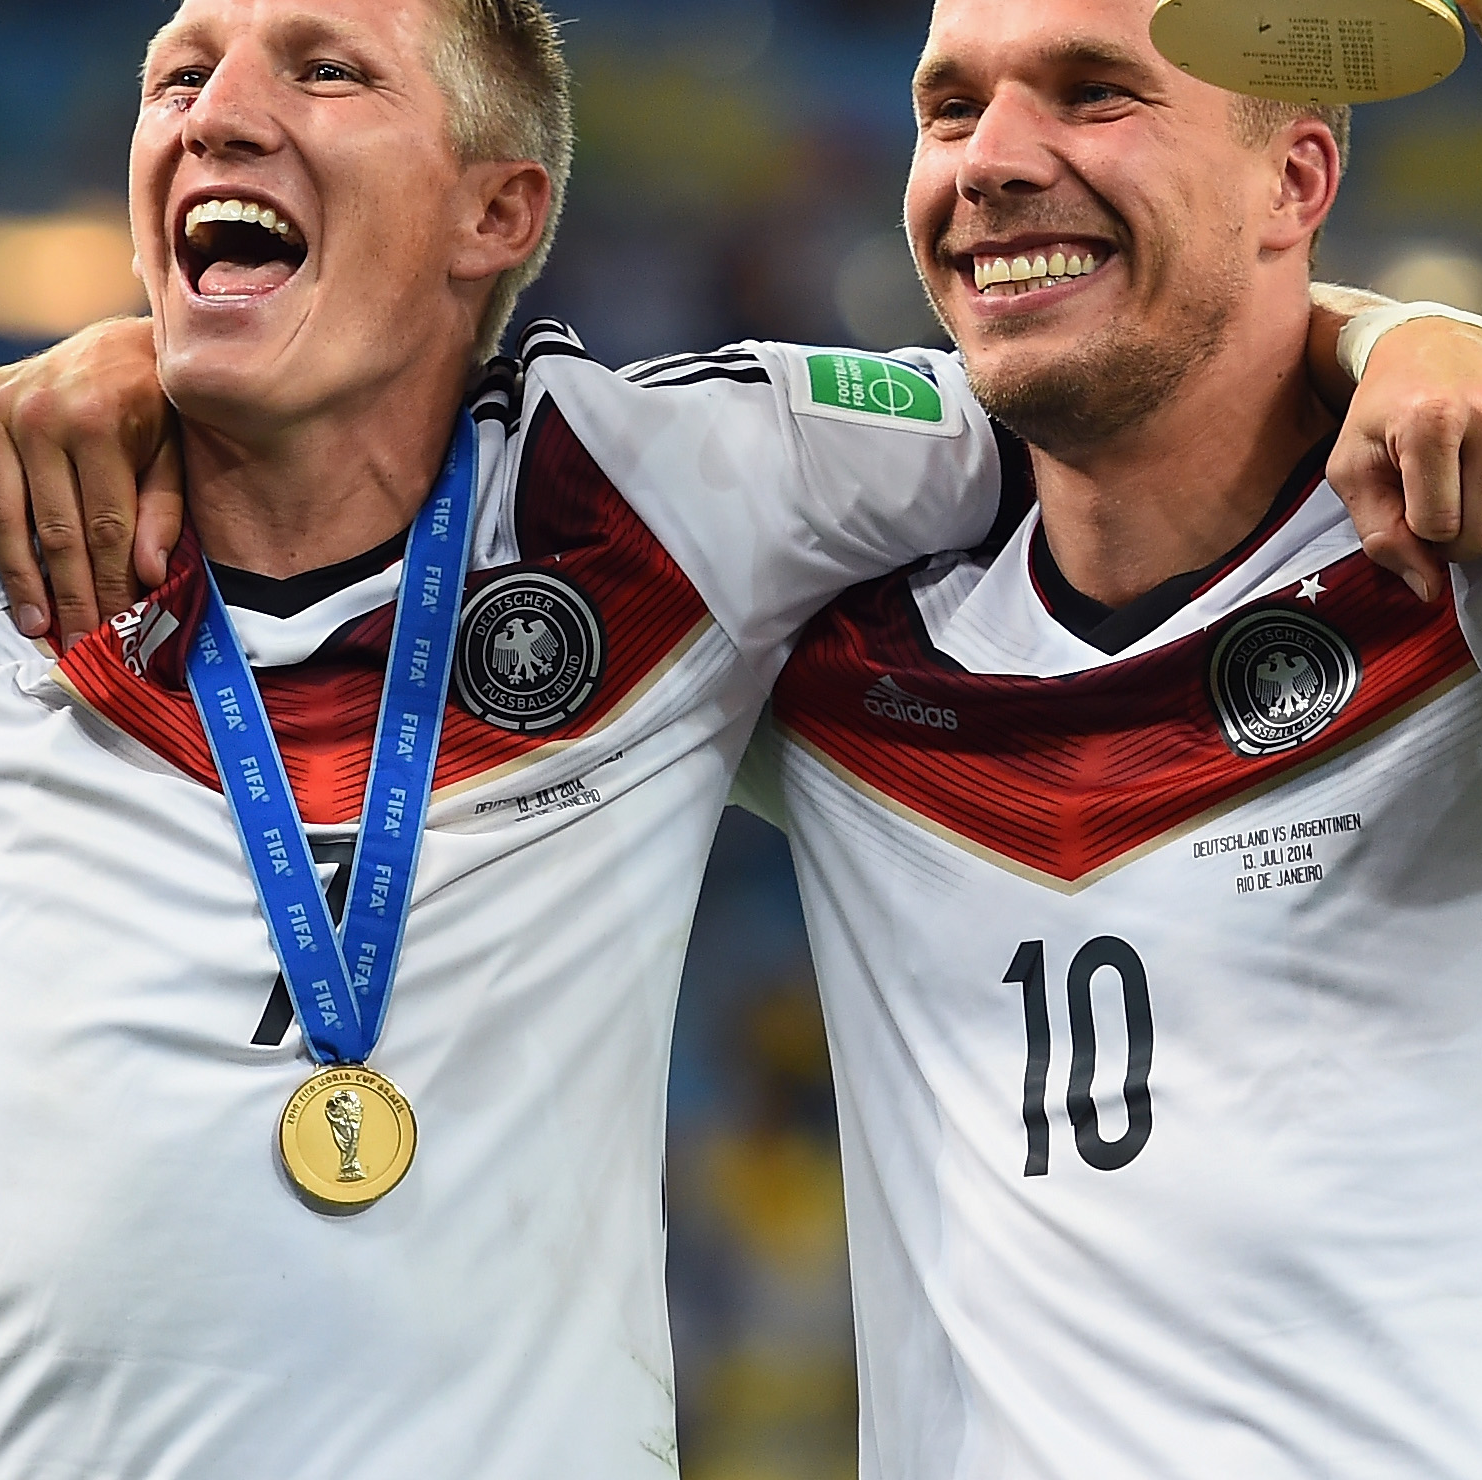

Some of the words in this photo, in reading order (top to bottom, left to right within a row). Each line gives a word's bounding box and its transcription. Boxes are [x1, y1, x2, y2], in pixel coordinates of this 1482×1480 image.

[852, 383, 865, 406] FOR
[475, 593, 554, 636] DEUTSCHER
[1235, 629, 1314, 664] DEUTSCHER
[482, 655, 580, 709] FUSSBALL-BUND
[863, 700, 958, 731] adidas
[1243, 693, 1332, 739] FUSSBALL-BUND
[535, 787, 558, 807] JULI
[558, 778, 585, 798] 2014
[1193, 830, 1268, 858] DEUTSCHLAND
[1272, 826, 1286, 842] VS
[1291, 813, 1361, 840] ARGENTINIEN
[1242, 853, 1257, 871] 13.
[1260, 847, 1284, 867] JULI
[1287, 843, 1313, 863] 2014
[1237, 876, 1254, 894] RIO
[1258, 872, 1272, 890] DE
[1276, 864, 1323, 887] JANEIRO
[1002, 936, 1153, 1177] 10
[299, 1084, 318, 1102] FIFA
[317, 1072, 351, 1087] WORLD
[355, 1073, 375, 1086] CUP
